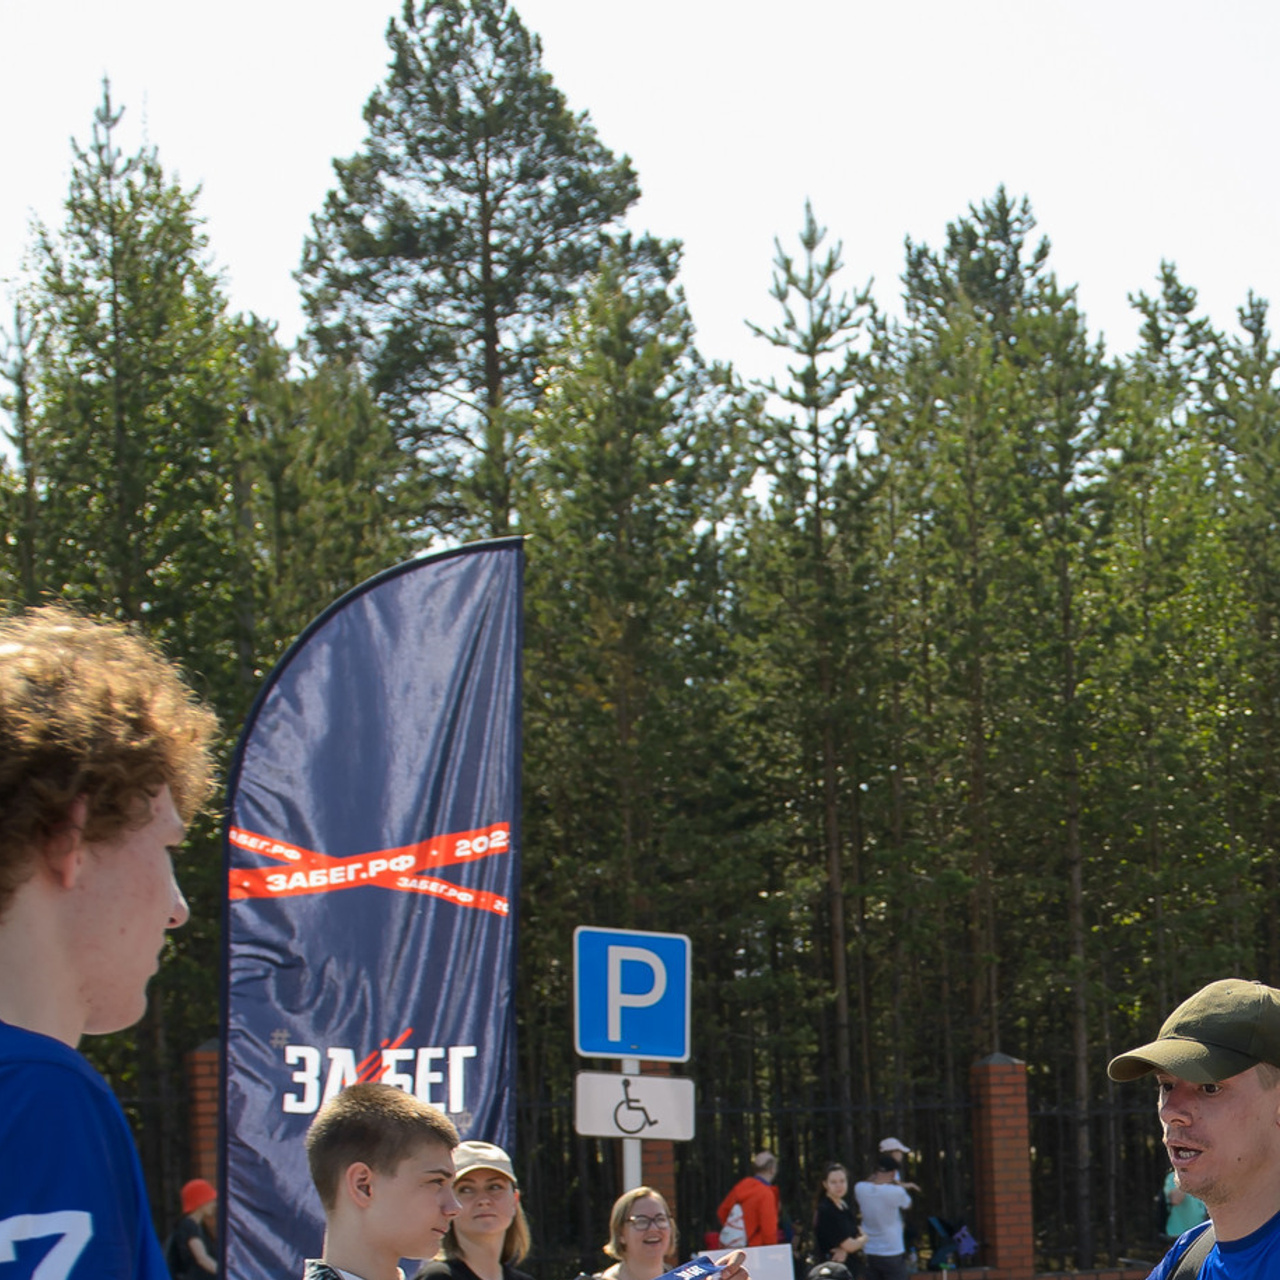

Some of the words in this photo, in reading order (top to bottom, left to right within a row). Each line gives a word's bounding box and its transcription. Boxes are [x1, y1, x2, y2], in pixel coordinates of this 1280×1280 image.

[266, 854, 416, 892] ЗАБЕГ.РФ
[396, 875, 474, 902] ЗАБЕГ.РФ
[607, 945, 667, 1042] P
